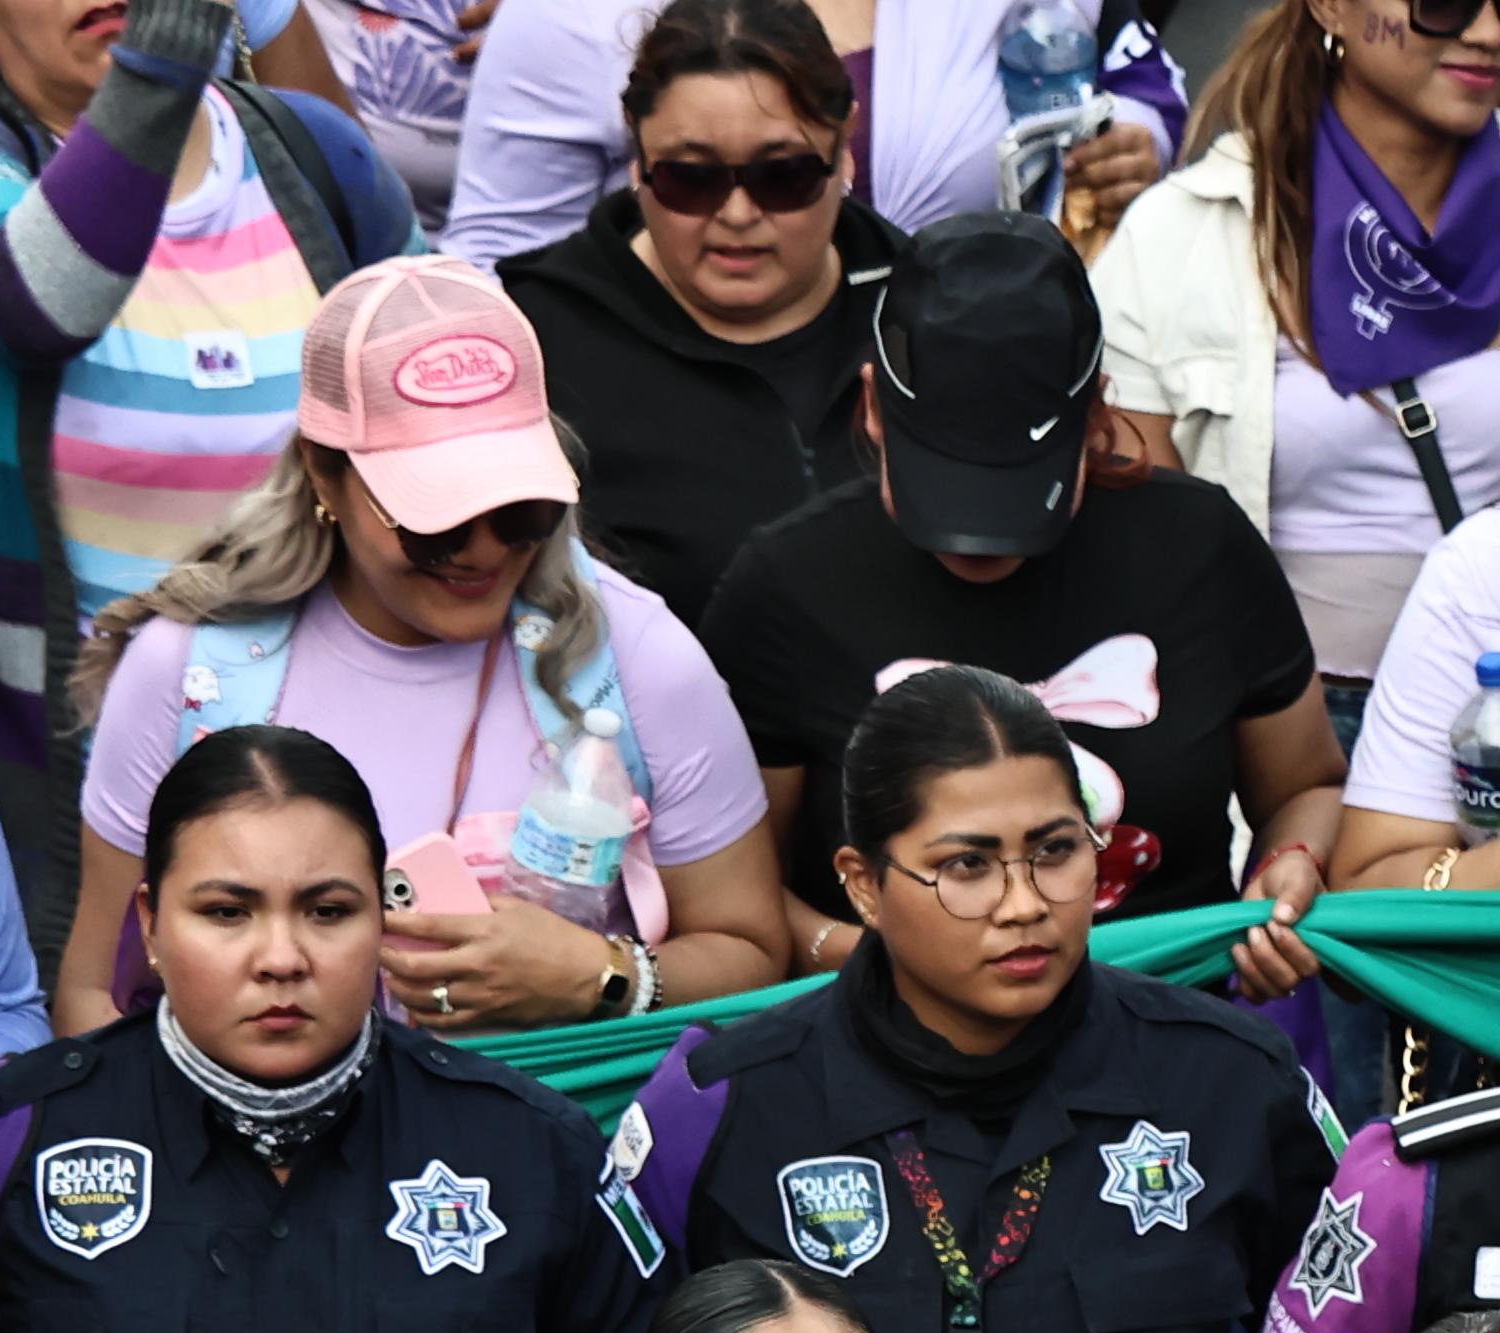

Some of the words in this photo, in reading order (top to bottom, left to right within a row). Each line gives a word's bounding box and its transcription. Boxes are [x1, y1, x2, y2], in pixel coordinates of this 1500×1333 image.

[49, 1153, 136, 1180] POLICÍA
[49, 1176, 137, 1196] ESTATAL
[789, 1169, 871, 1199] POLICÍA
[58, 1193, 126, 1206] COAHUILA
[795, 1192, 874, 1216] ESTATAL
